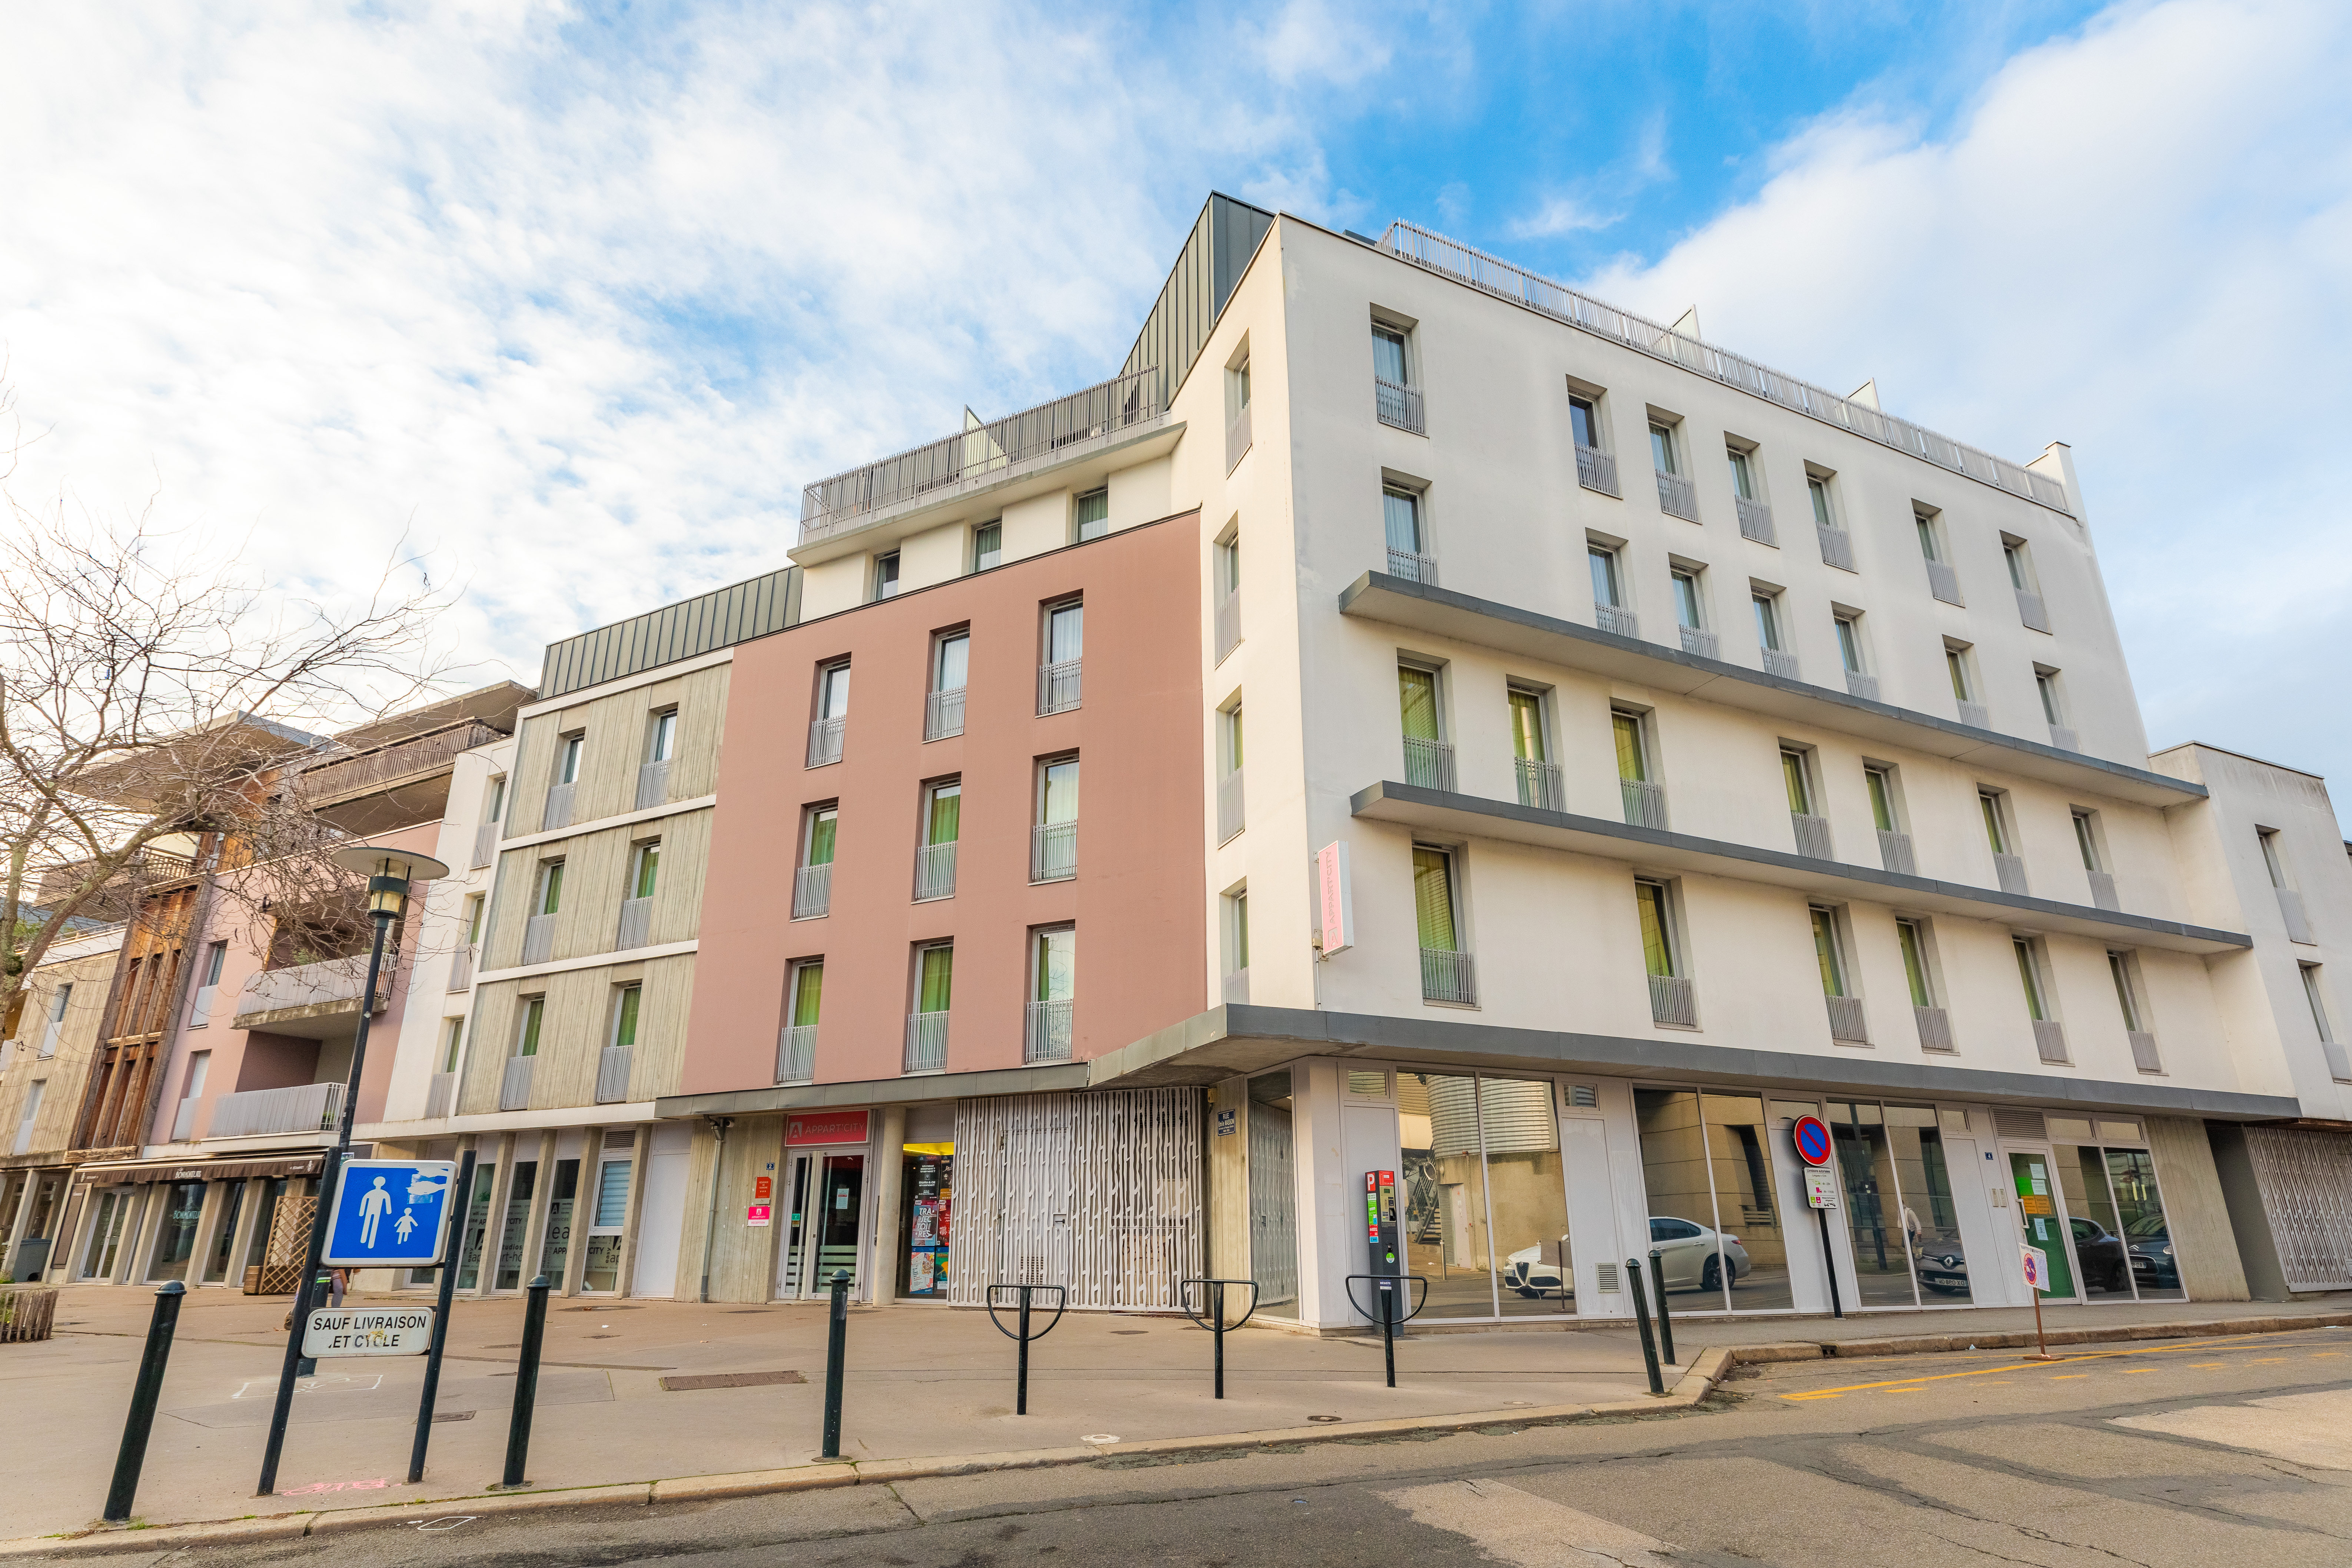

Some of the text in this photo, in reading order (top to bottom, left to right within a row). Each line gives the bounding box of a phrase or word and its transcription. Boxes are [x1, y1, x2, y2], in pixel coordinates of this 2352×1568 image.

[1326, 851, 1335, 924] APPART'CITY
[805, 1123, 865, 1134] APPART'CITY
[1367, 1174, 1375, 1190] P
[313, 1316, 426, 1330] SAUF LIVRAISON
[333, 1335, 351, 1348] ET
